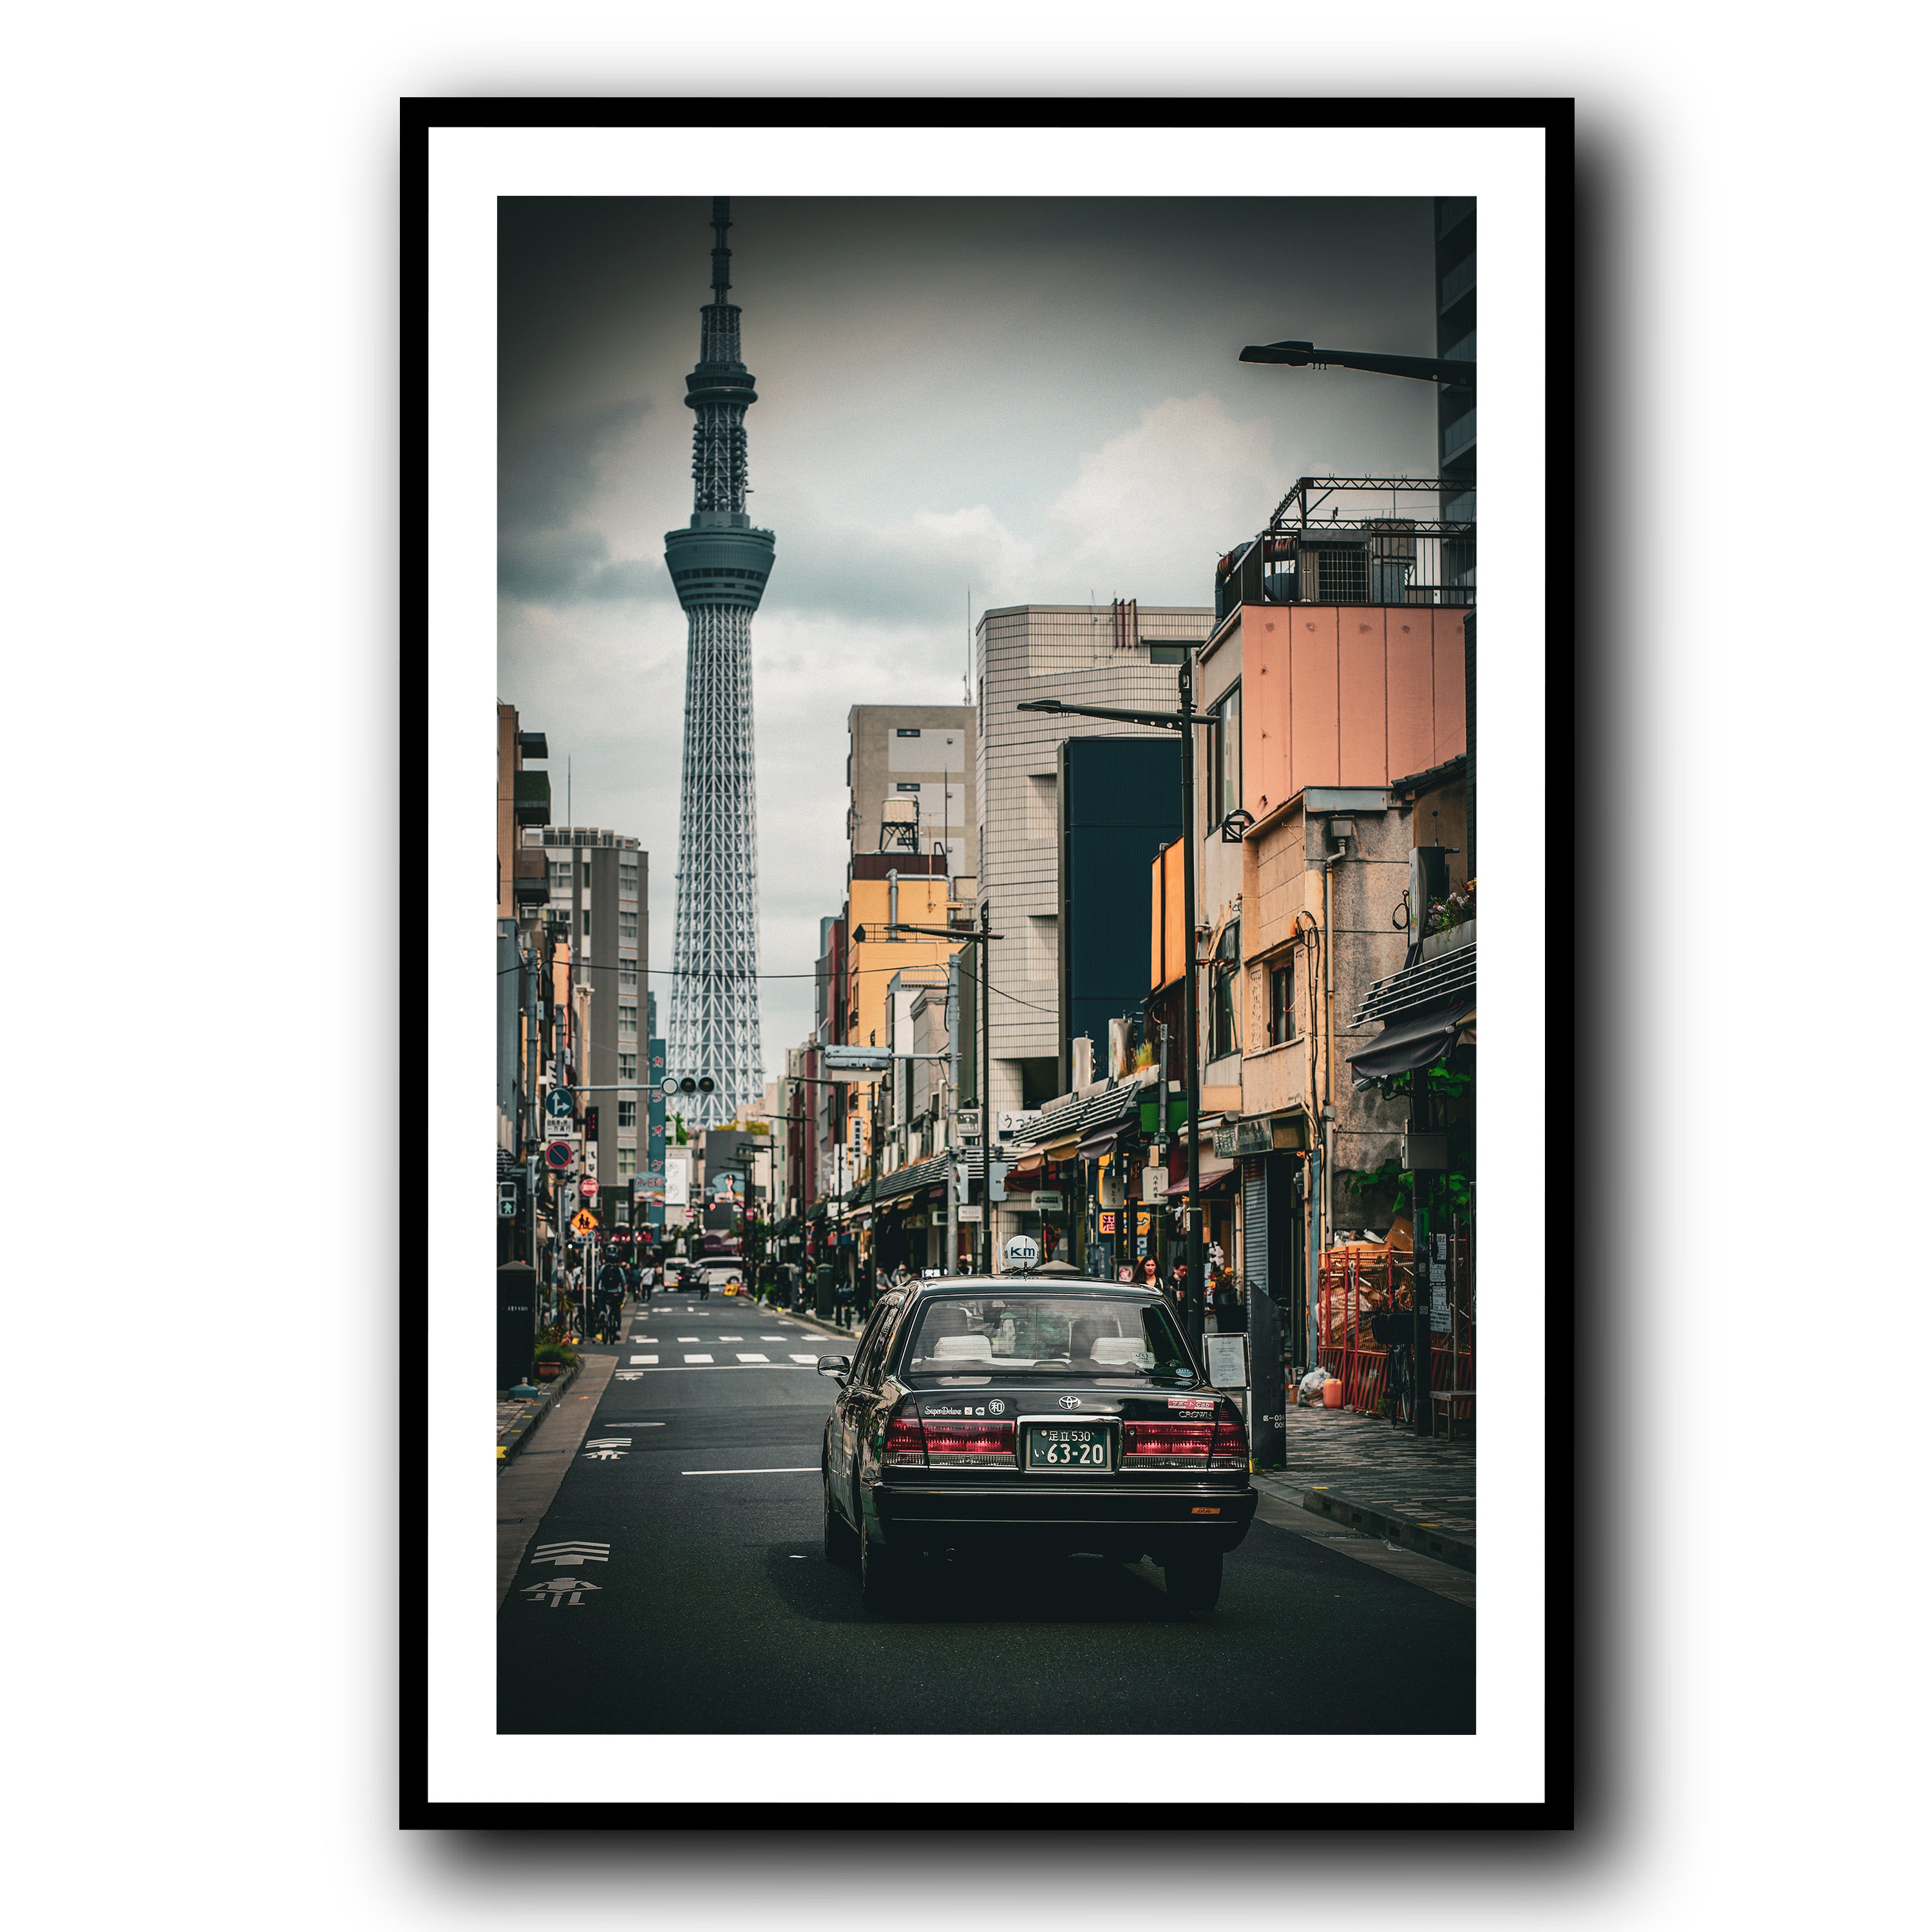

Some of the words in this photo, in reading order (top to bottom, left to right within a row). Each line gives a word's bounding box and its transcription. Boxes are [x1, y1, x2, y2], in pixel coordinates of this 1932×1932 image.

[1179, 1410, 1213, 1419] CROWN
[1048, 1430, 1070, 1441] 足立
[1071, 1431, 1091, 1442] 530
[1047, 1443, 1104, 1464] 63-20
